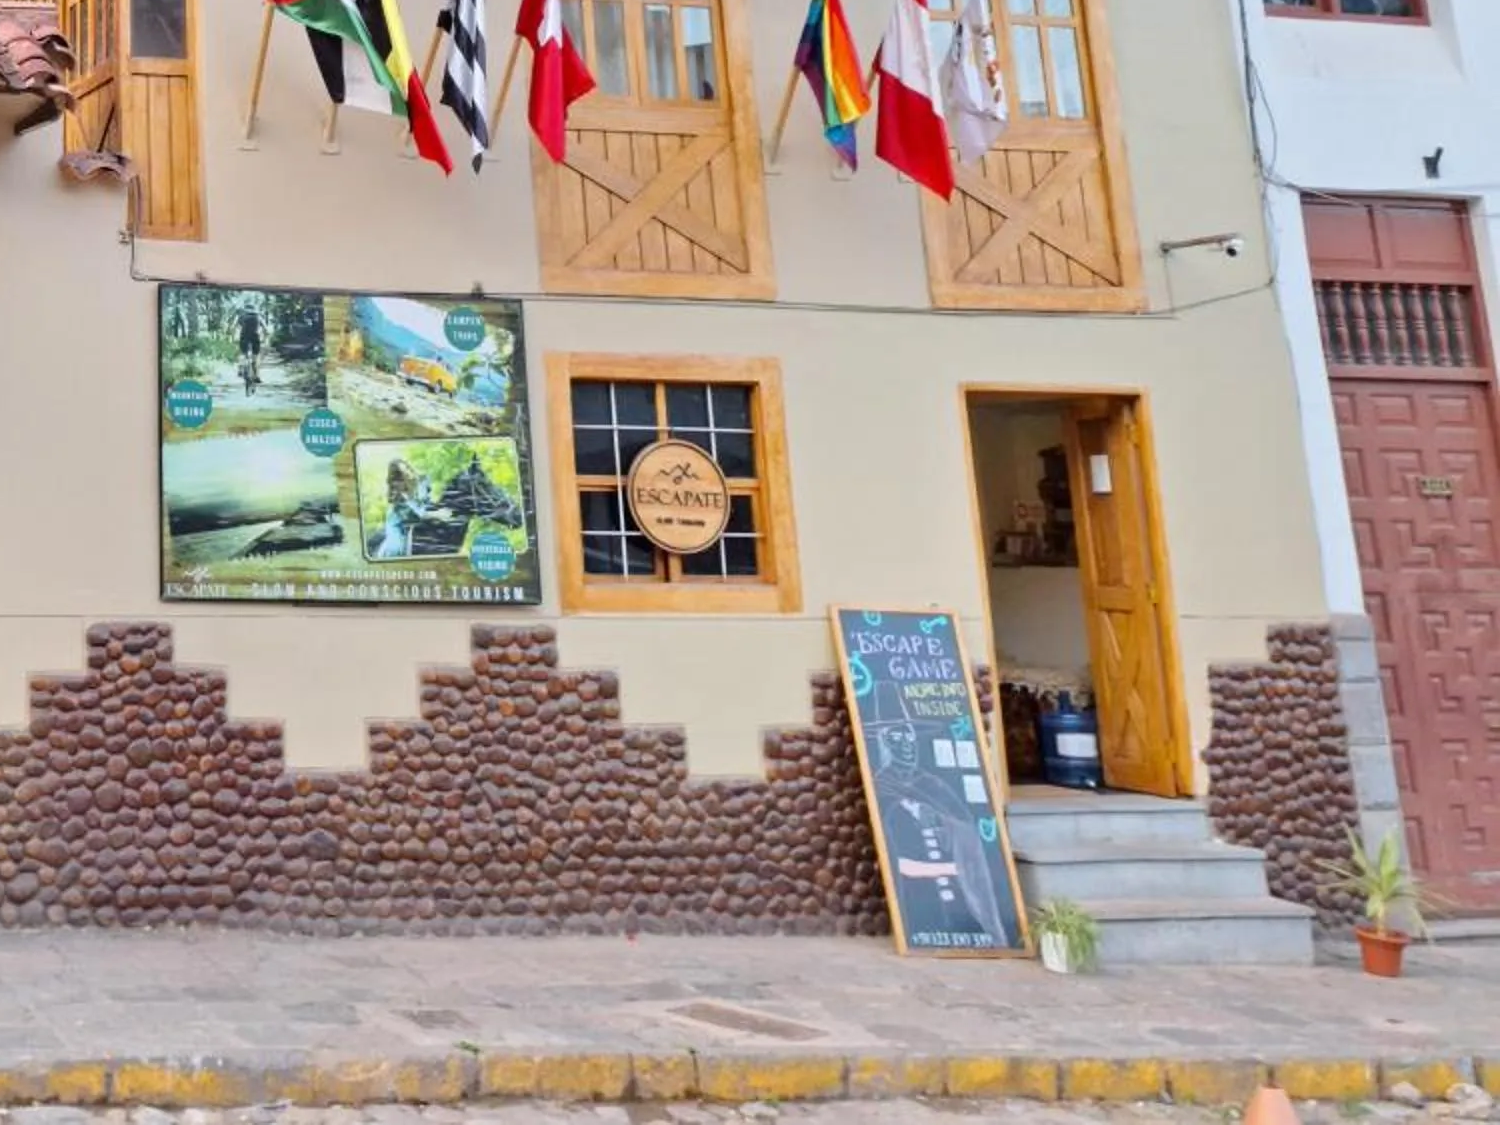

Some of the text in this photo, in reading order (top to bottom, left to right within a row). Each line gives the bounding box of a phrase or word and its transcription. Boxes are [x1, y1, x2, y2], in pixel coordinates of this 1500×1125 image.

[636, 487, 723, 510] ESCAPATE
[452, 586, 524, 601] TOURISM
[851, 632, 944, 655] ESCAPE
[888, 656, 957, 680] GAME
